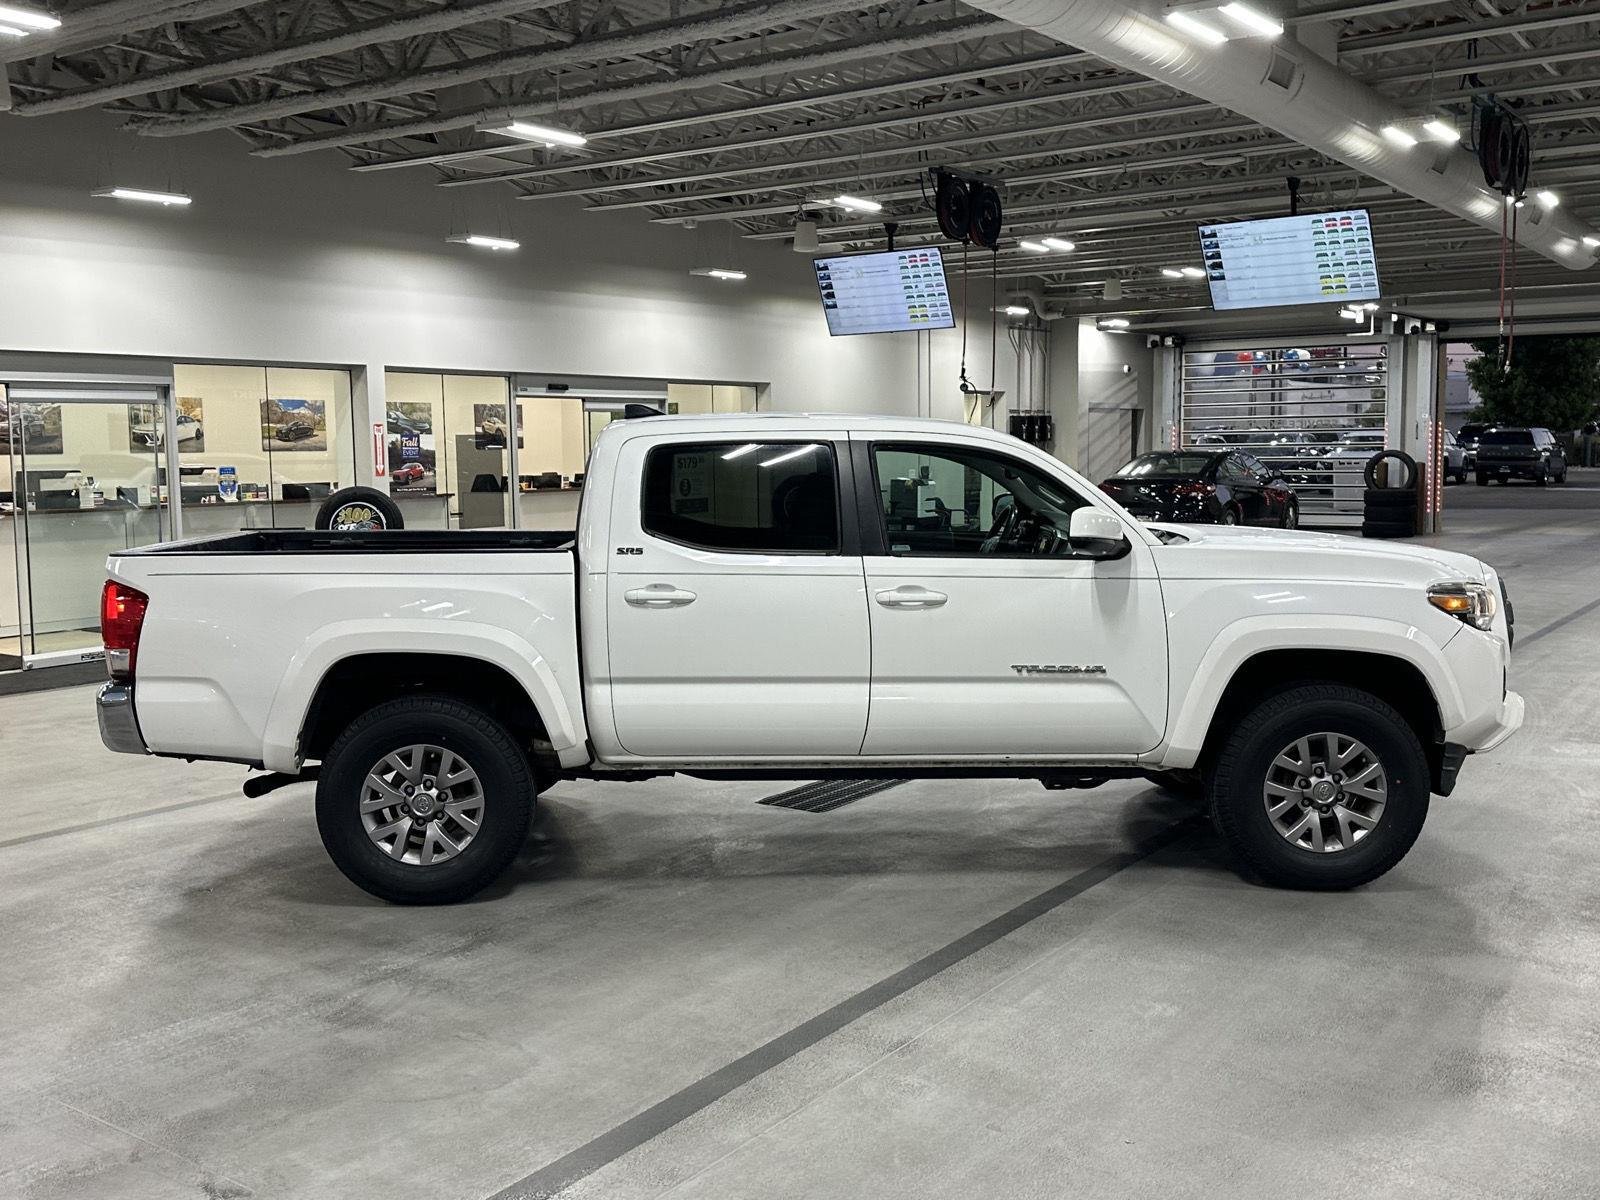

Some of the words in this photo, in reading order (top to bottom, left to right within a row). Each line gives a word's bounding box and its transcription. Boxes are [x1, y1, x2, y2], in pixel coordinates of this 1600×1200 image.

[401, 436, 419, 447] Fall
[337, 507, 372, 524] $100
[616, 547, 644, 555] SR5
[1010, 664, 1107, 675] TACOMA
